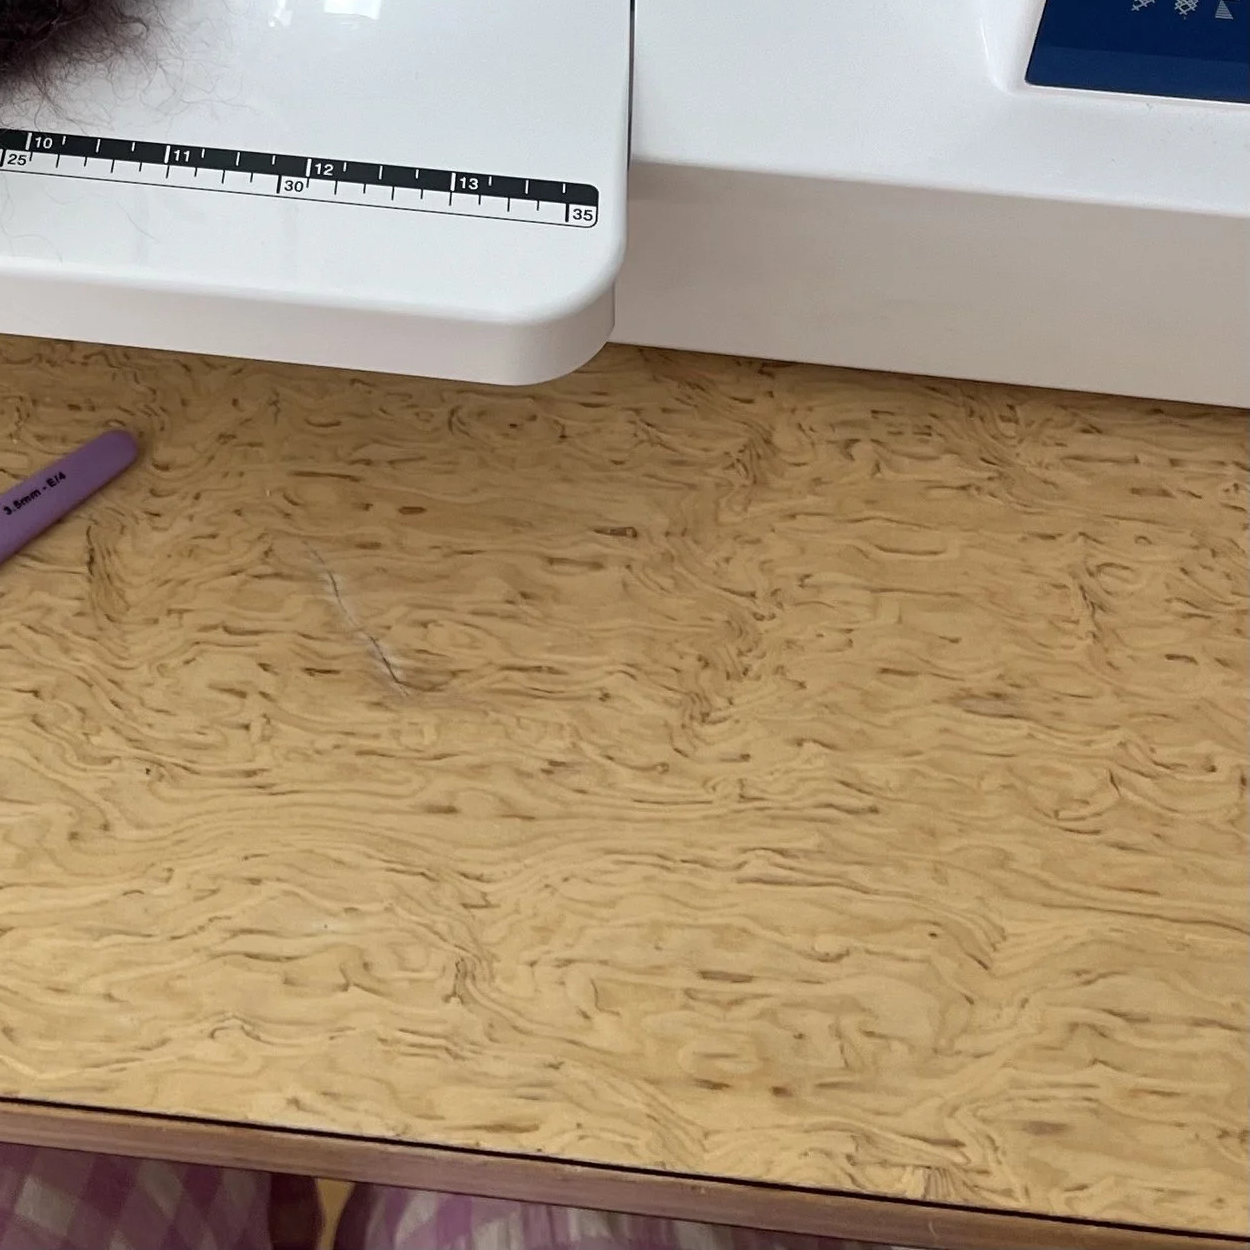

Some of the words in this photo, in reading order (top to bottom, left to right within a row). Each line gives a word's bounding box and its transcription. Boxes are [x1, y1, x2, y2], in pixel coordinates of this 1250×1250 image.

[7, 153, 27, 166] 25
[284, 179, 304, 193] 30
[572, 208, 594, 222] 35
[34, 136, 53, 150] 10
[173, 149, 192, 163] 11
[314, 162, 335, 177] 12
[459, 176, 480, 190] 13
